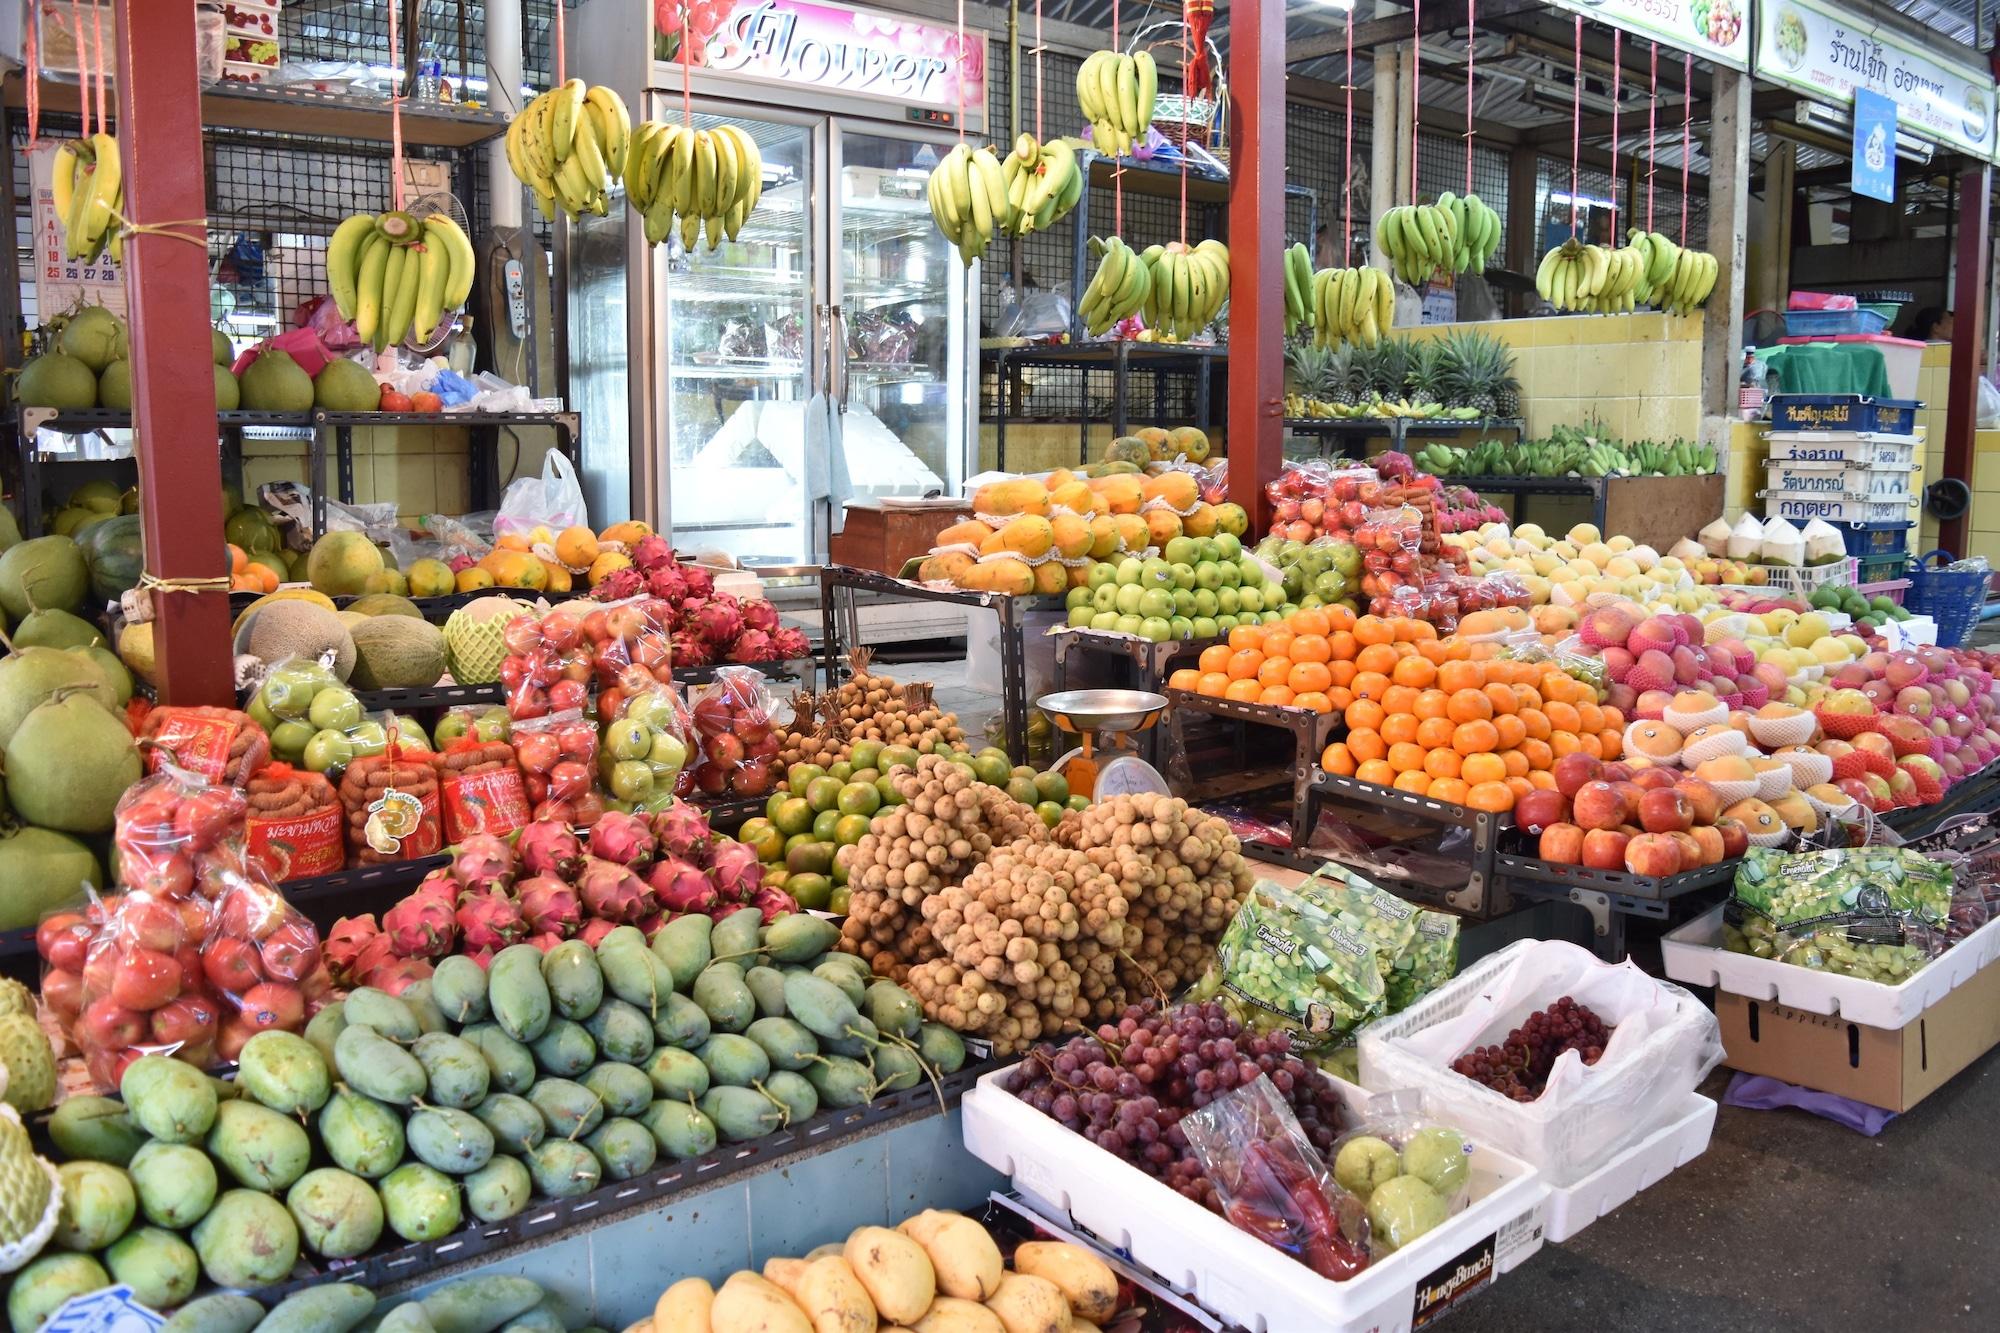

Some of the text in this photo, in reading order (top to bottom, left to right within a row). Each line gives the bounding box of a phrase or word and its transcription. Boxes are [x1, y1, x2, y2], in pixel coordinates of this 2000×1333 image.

[705, 1, 947, 97] Flower
[48, 235, 58, 246] 11
[47, 251, 59, 263] 18
[47, 267, 115, 281] 25 26 27 28
[1779, 863, 1816, 876] Emerald
[1255, 924, 1297, 956] Emerald
[1771, 1005, 1840, 1031] Apples
